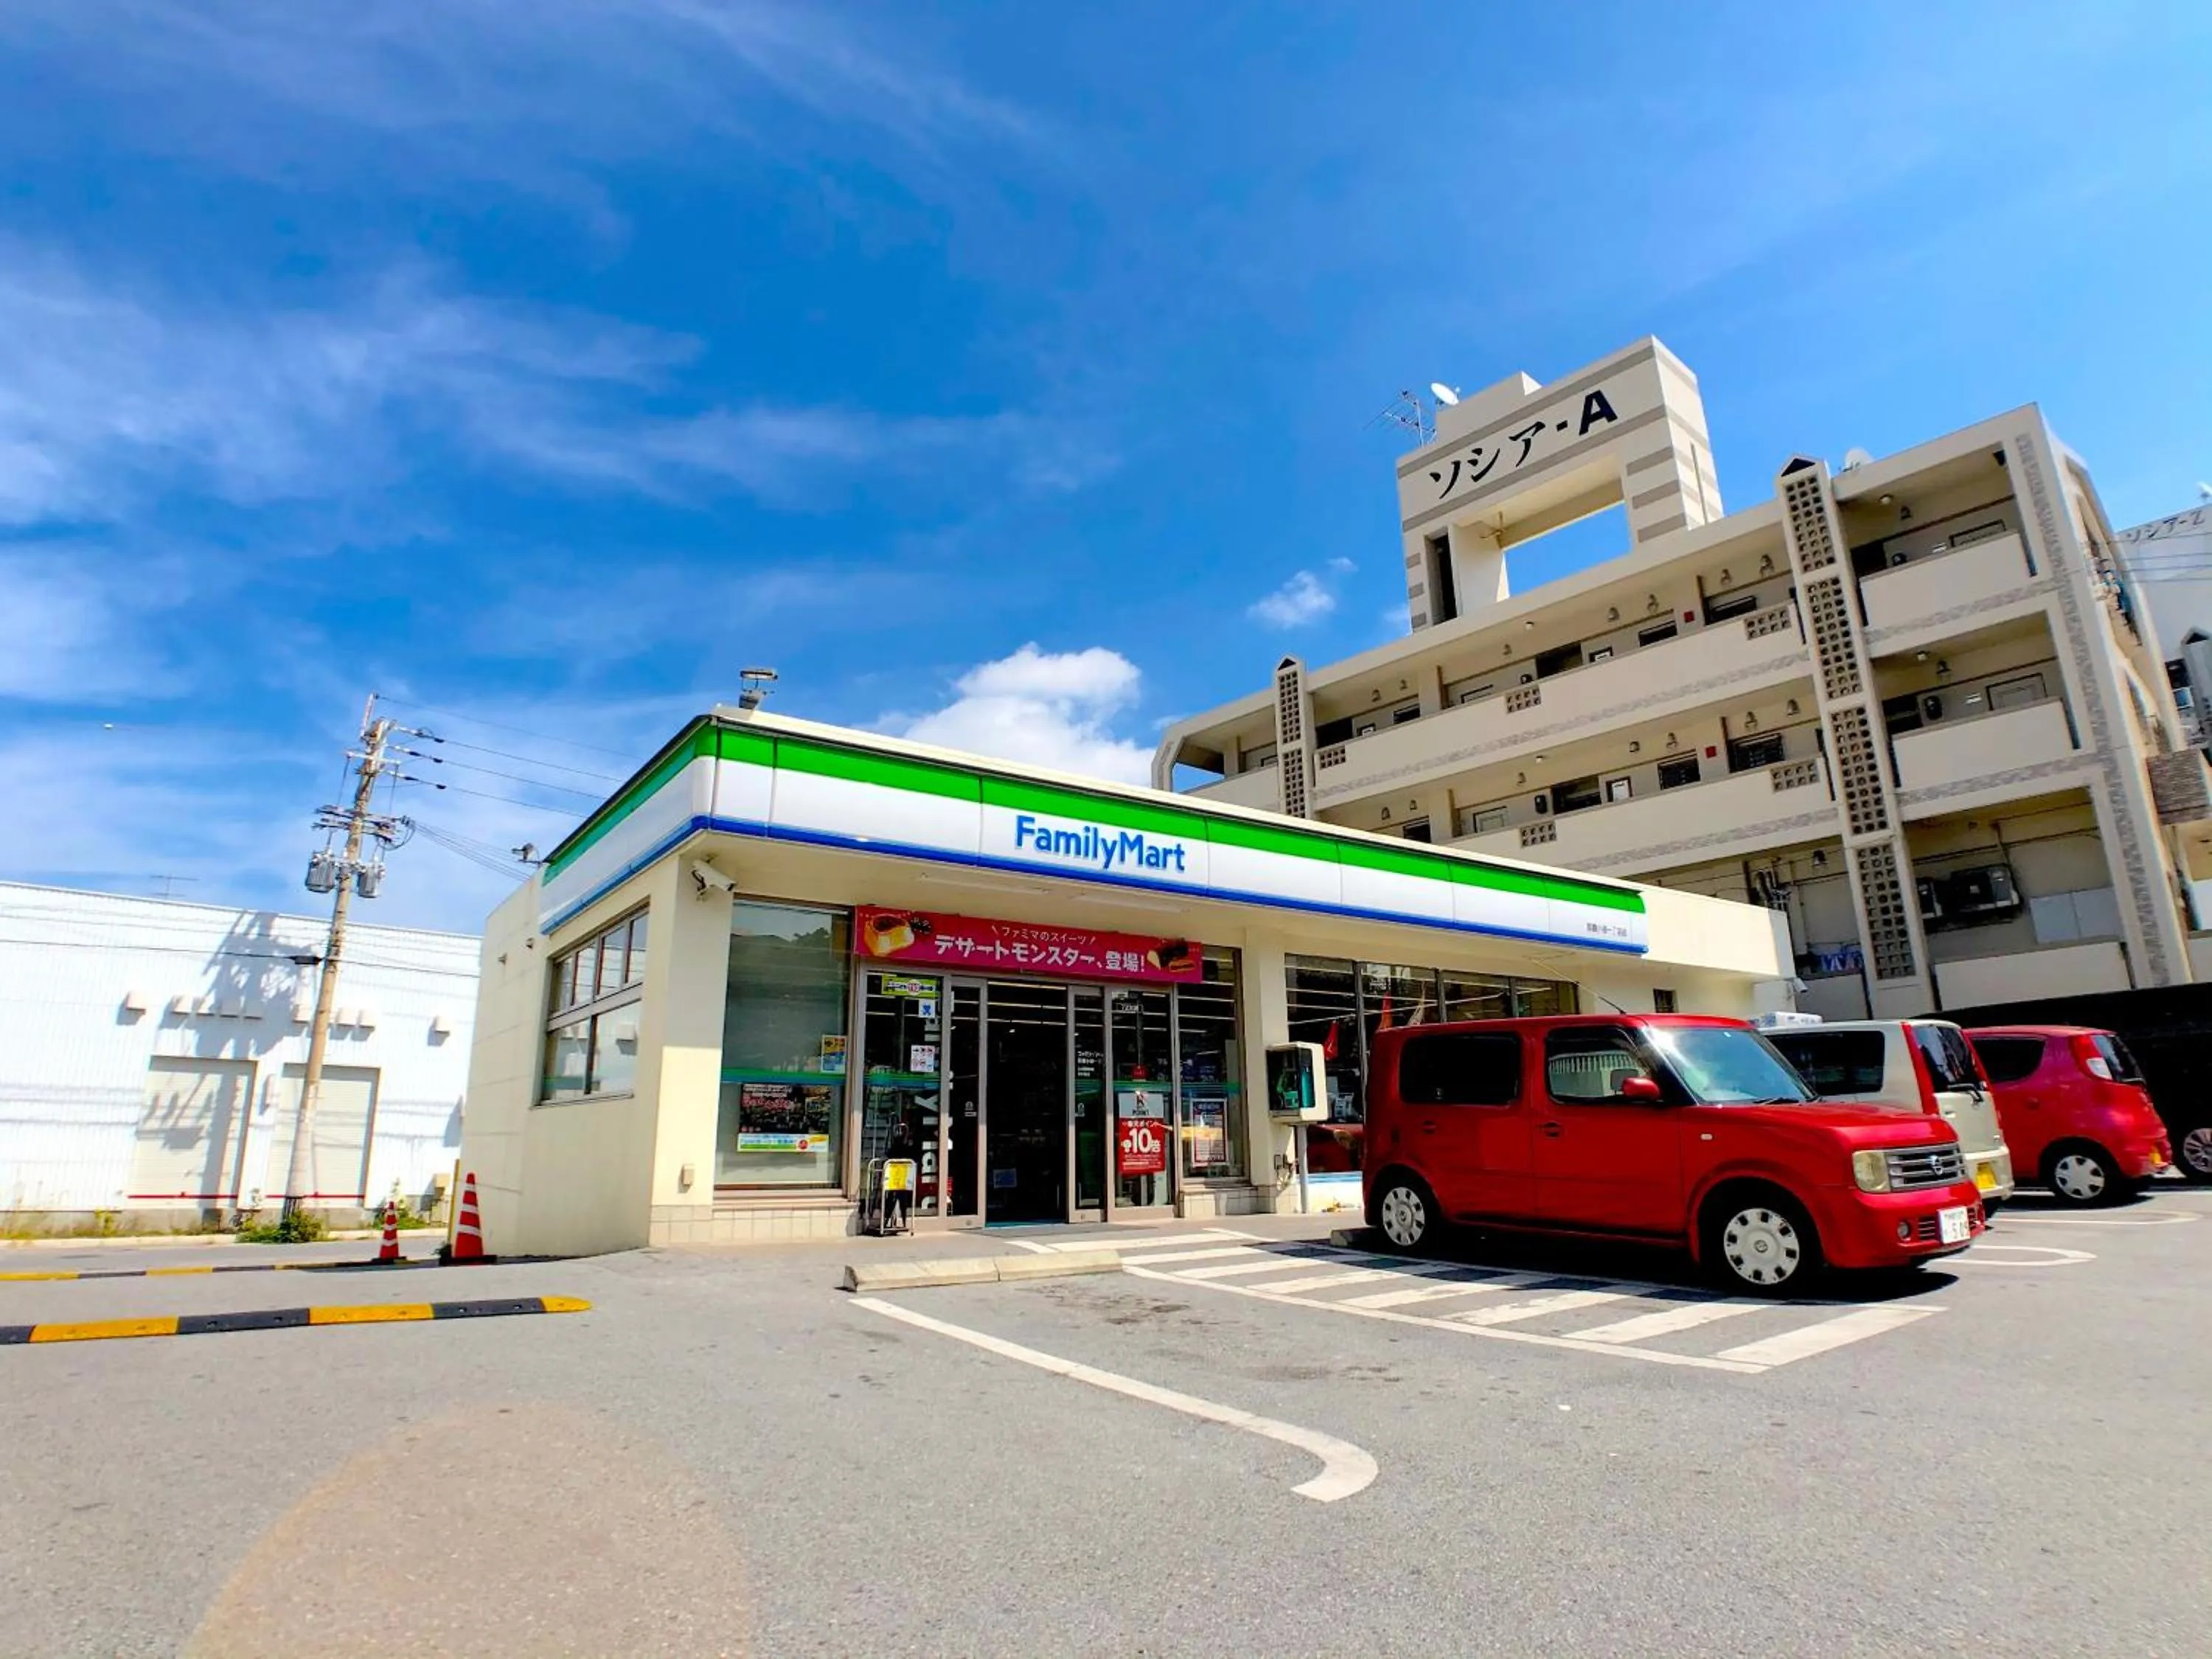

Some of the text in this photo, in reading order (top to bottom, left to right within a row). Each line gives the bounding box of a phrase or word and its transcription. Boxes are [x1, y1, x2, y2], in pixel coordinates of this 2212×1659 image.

[1015, 815, 1186, 872] FamilyMart
[1001, 926, 1088, 945] ファミマのスイーツ
